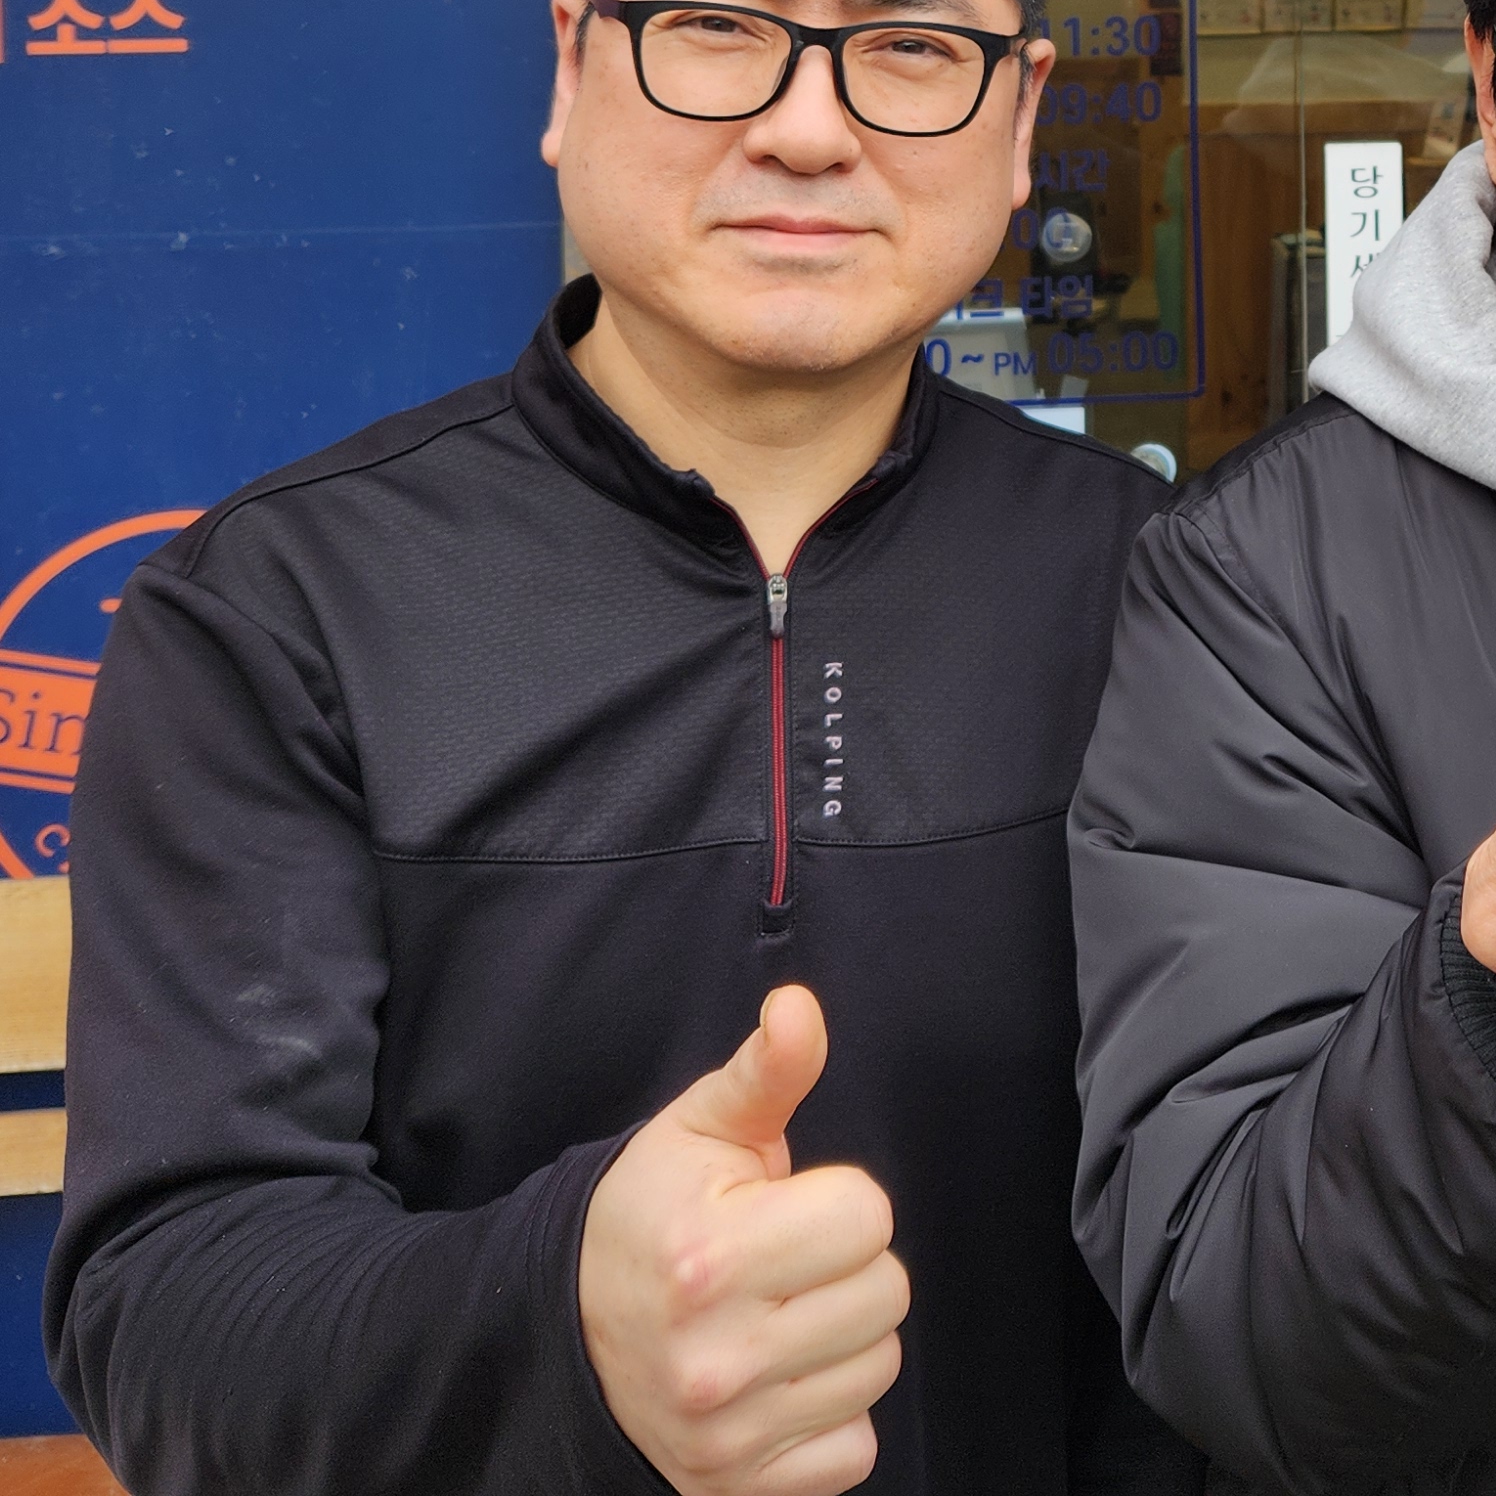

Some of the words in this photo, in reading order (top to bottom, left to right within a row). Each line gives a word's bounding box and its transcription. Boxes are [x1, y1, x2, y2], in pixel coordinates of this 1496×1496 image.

[994, 352, 1037, 376] PM
[1047, 330, 1178, 375] 05:00
[823, 662, 843, 818] KOLPING
